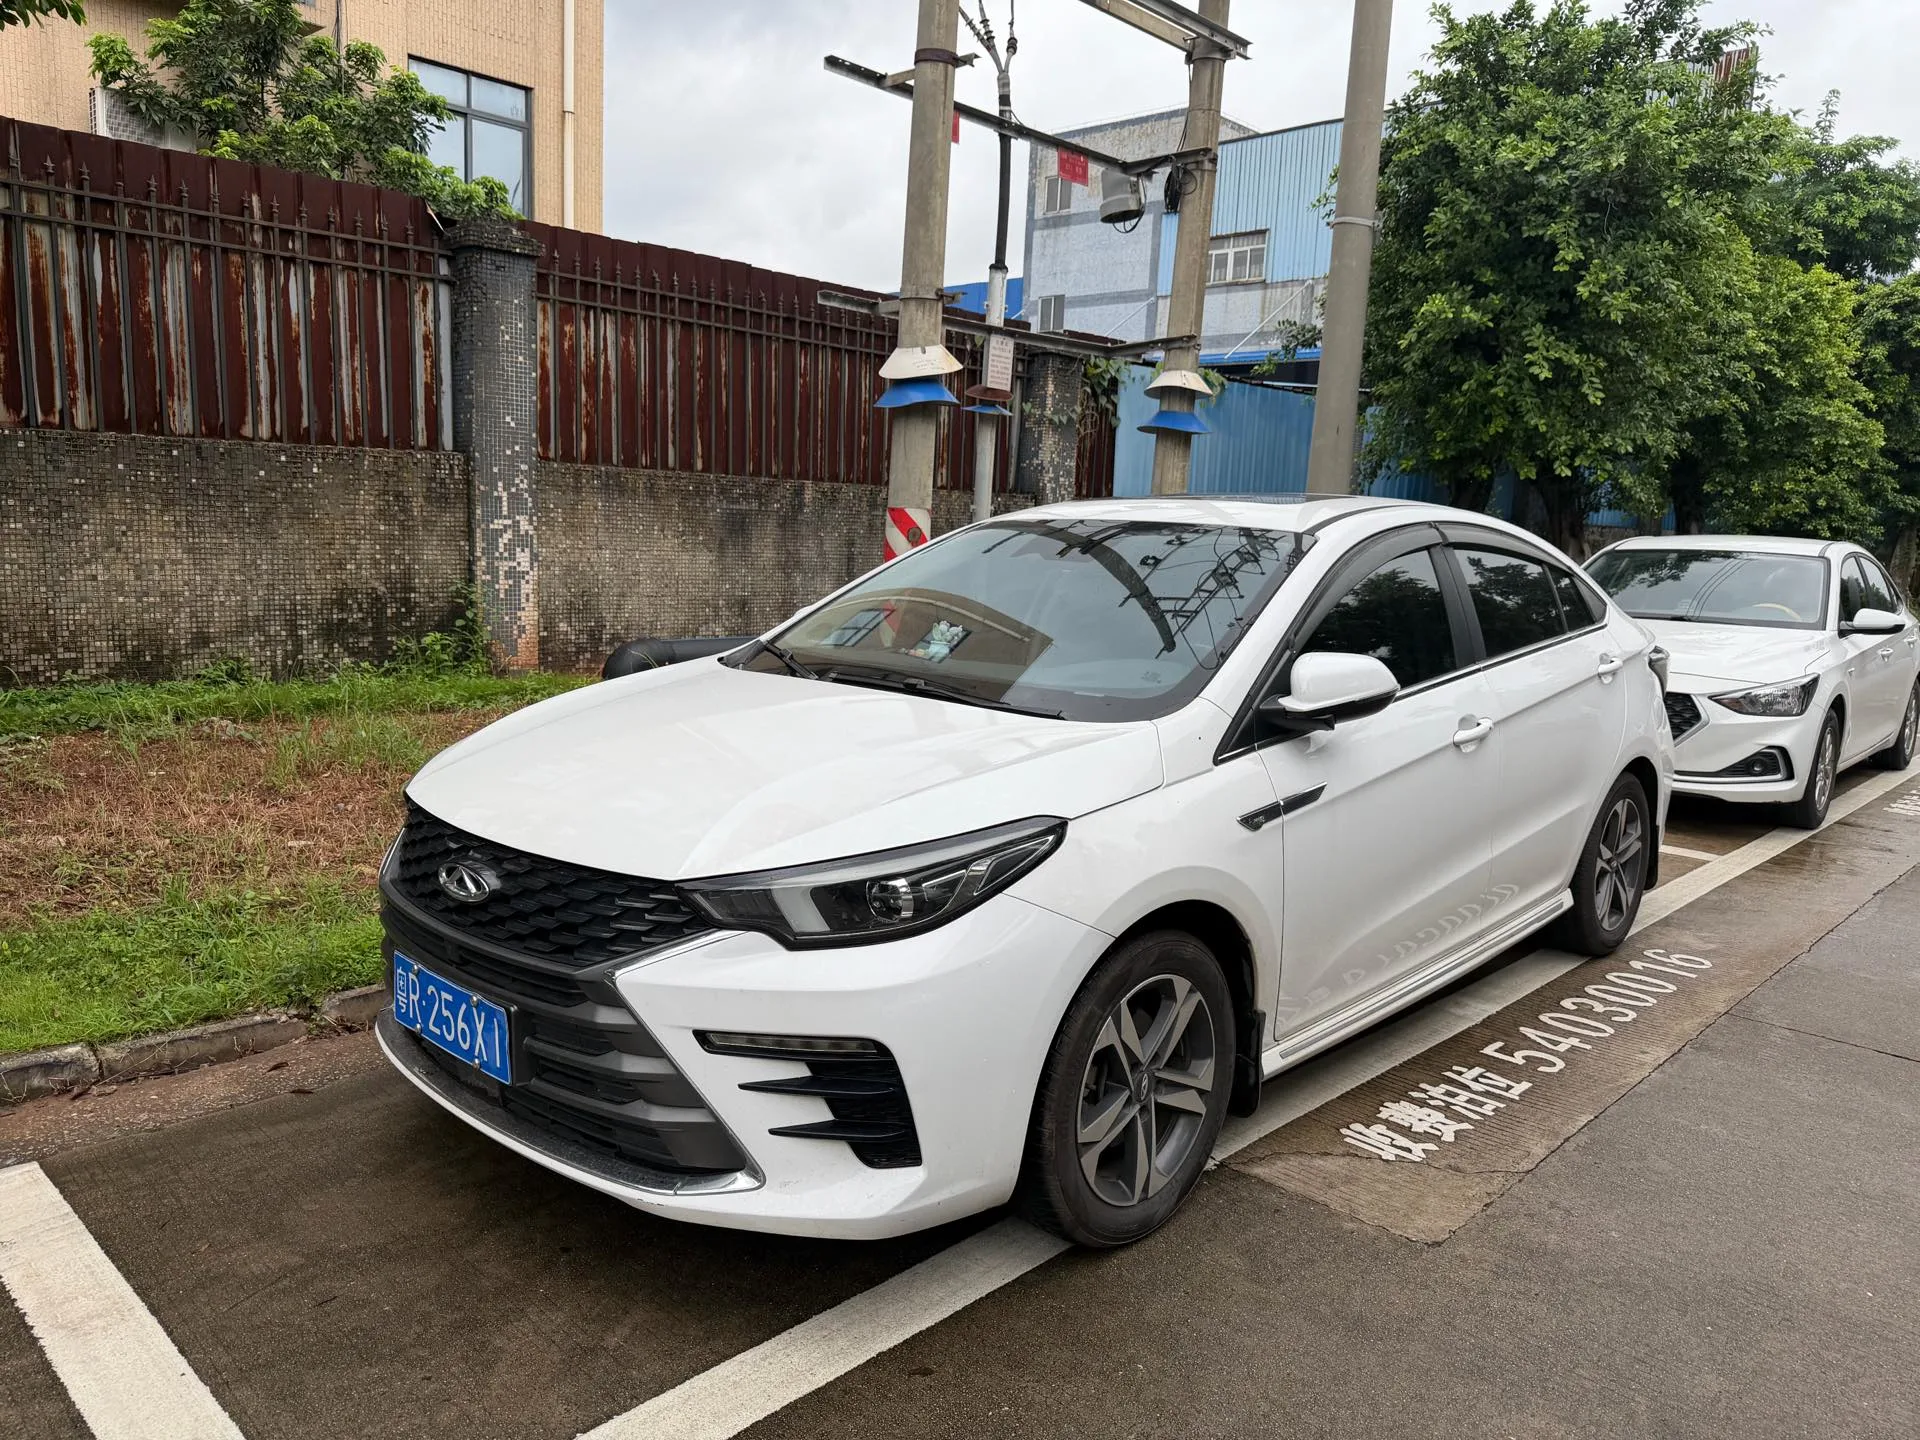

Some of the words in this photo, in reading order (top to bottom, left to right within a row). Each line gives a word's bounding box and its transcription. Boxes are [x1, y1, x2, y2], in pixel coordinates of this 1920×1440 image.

[1339, 1065, 1533, 1162] 收费泊位
[1478, 948, 1713, 1073] 54030016
